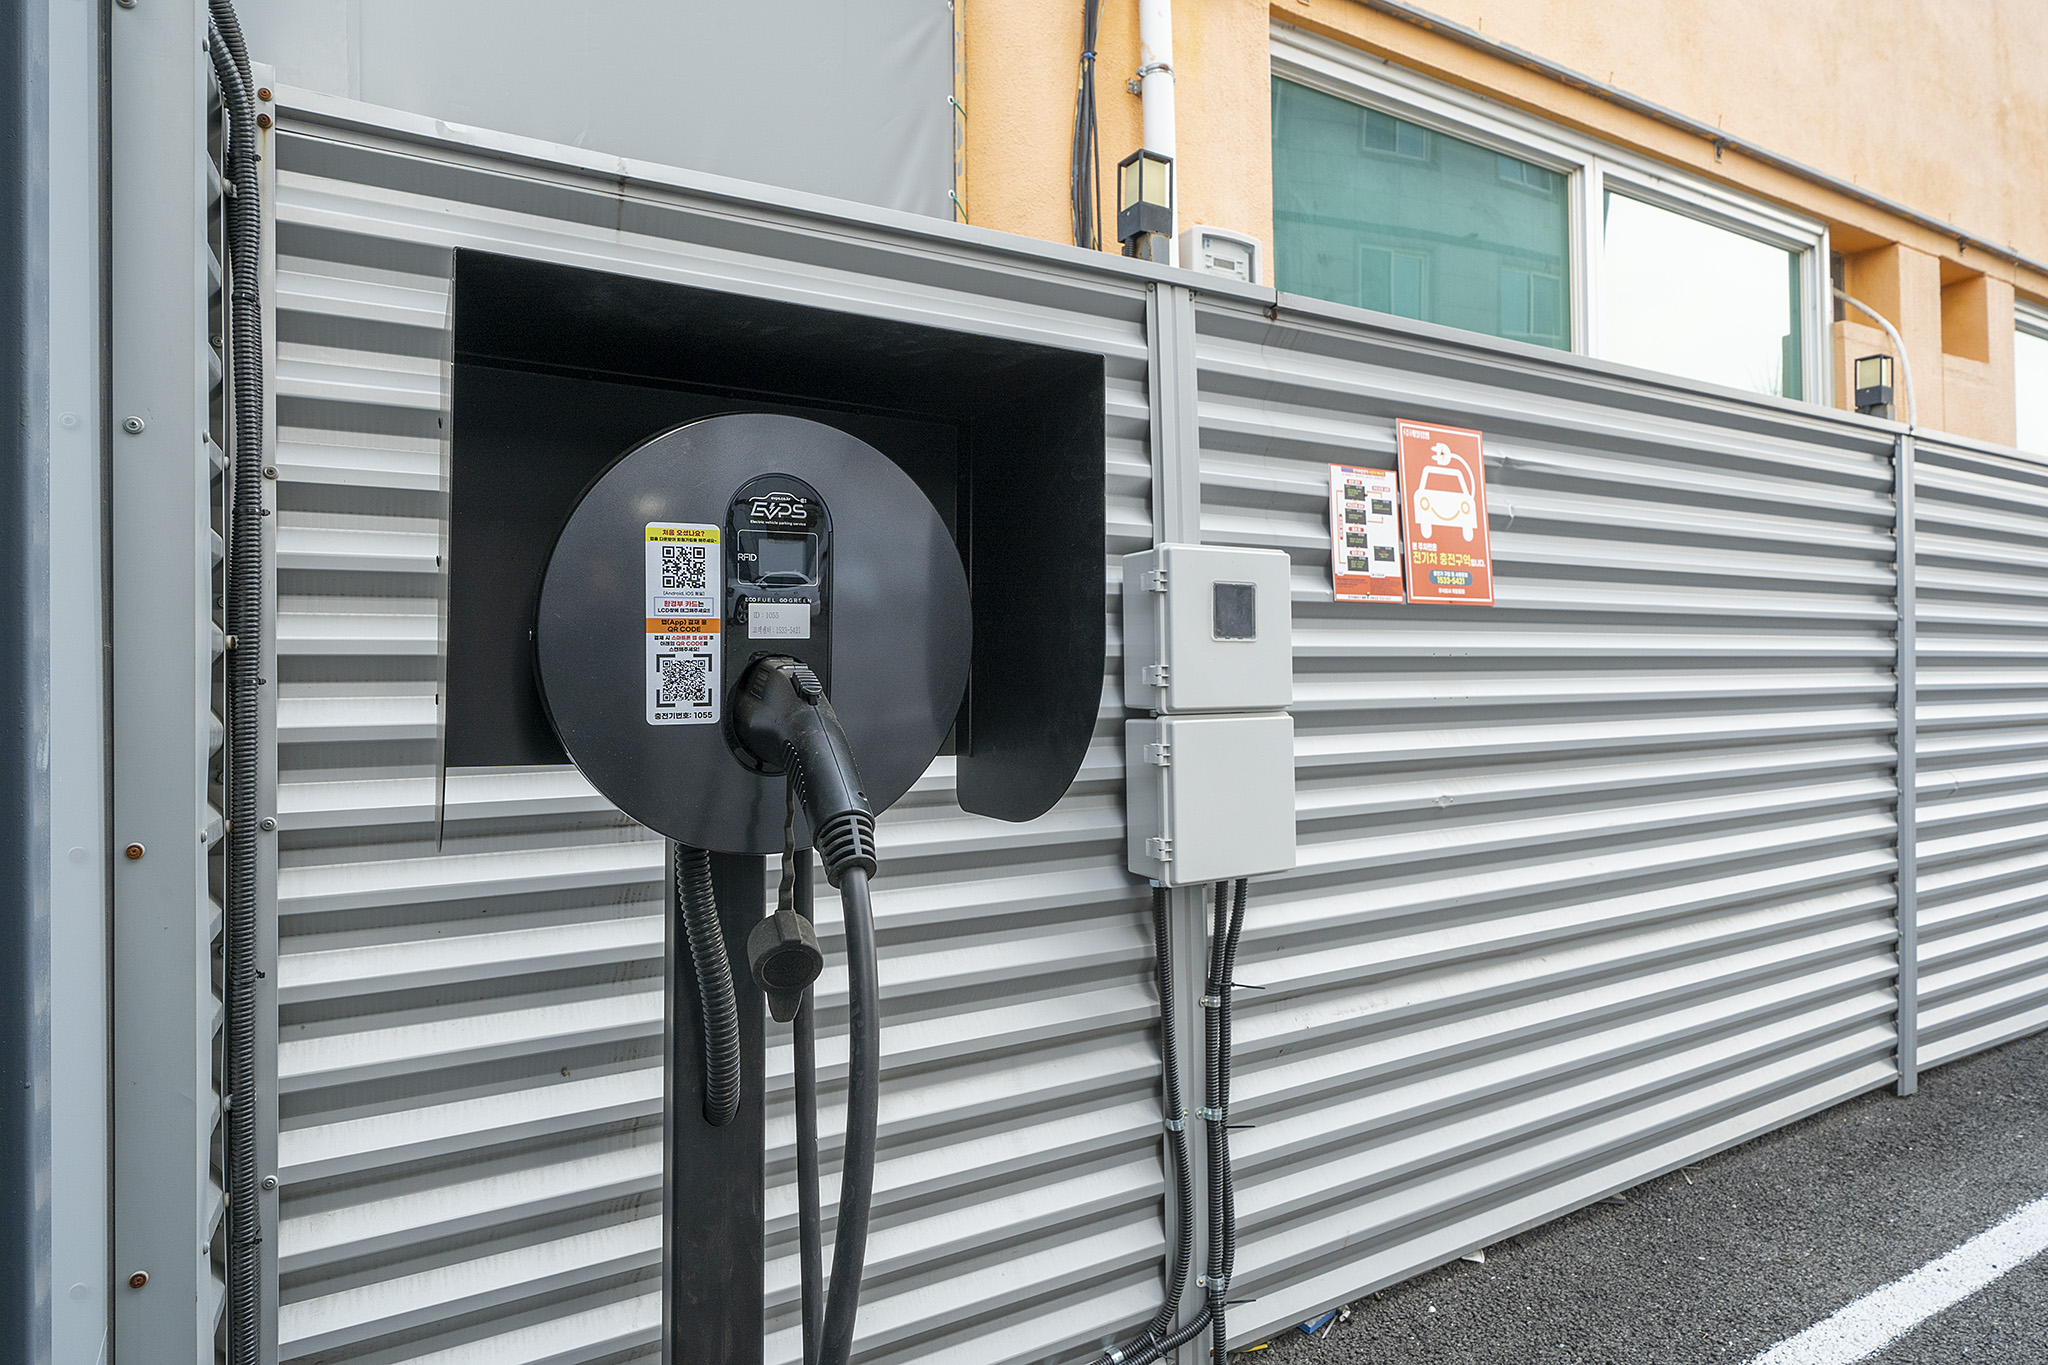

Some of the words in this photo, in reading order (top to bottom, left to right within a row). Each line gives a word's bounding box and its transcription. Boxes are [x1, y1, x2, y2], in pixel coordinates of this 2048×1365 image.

[750, 501, 807, 519] EVPS
[737, 552, 757, 561] RFID
[1413, 551, 1437, 565] 전기차
[1437, 576, 1465, 585] 1533-5421
